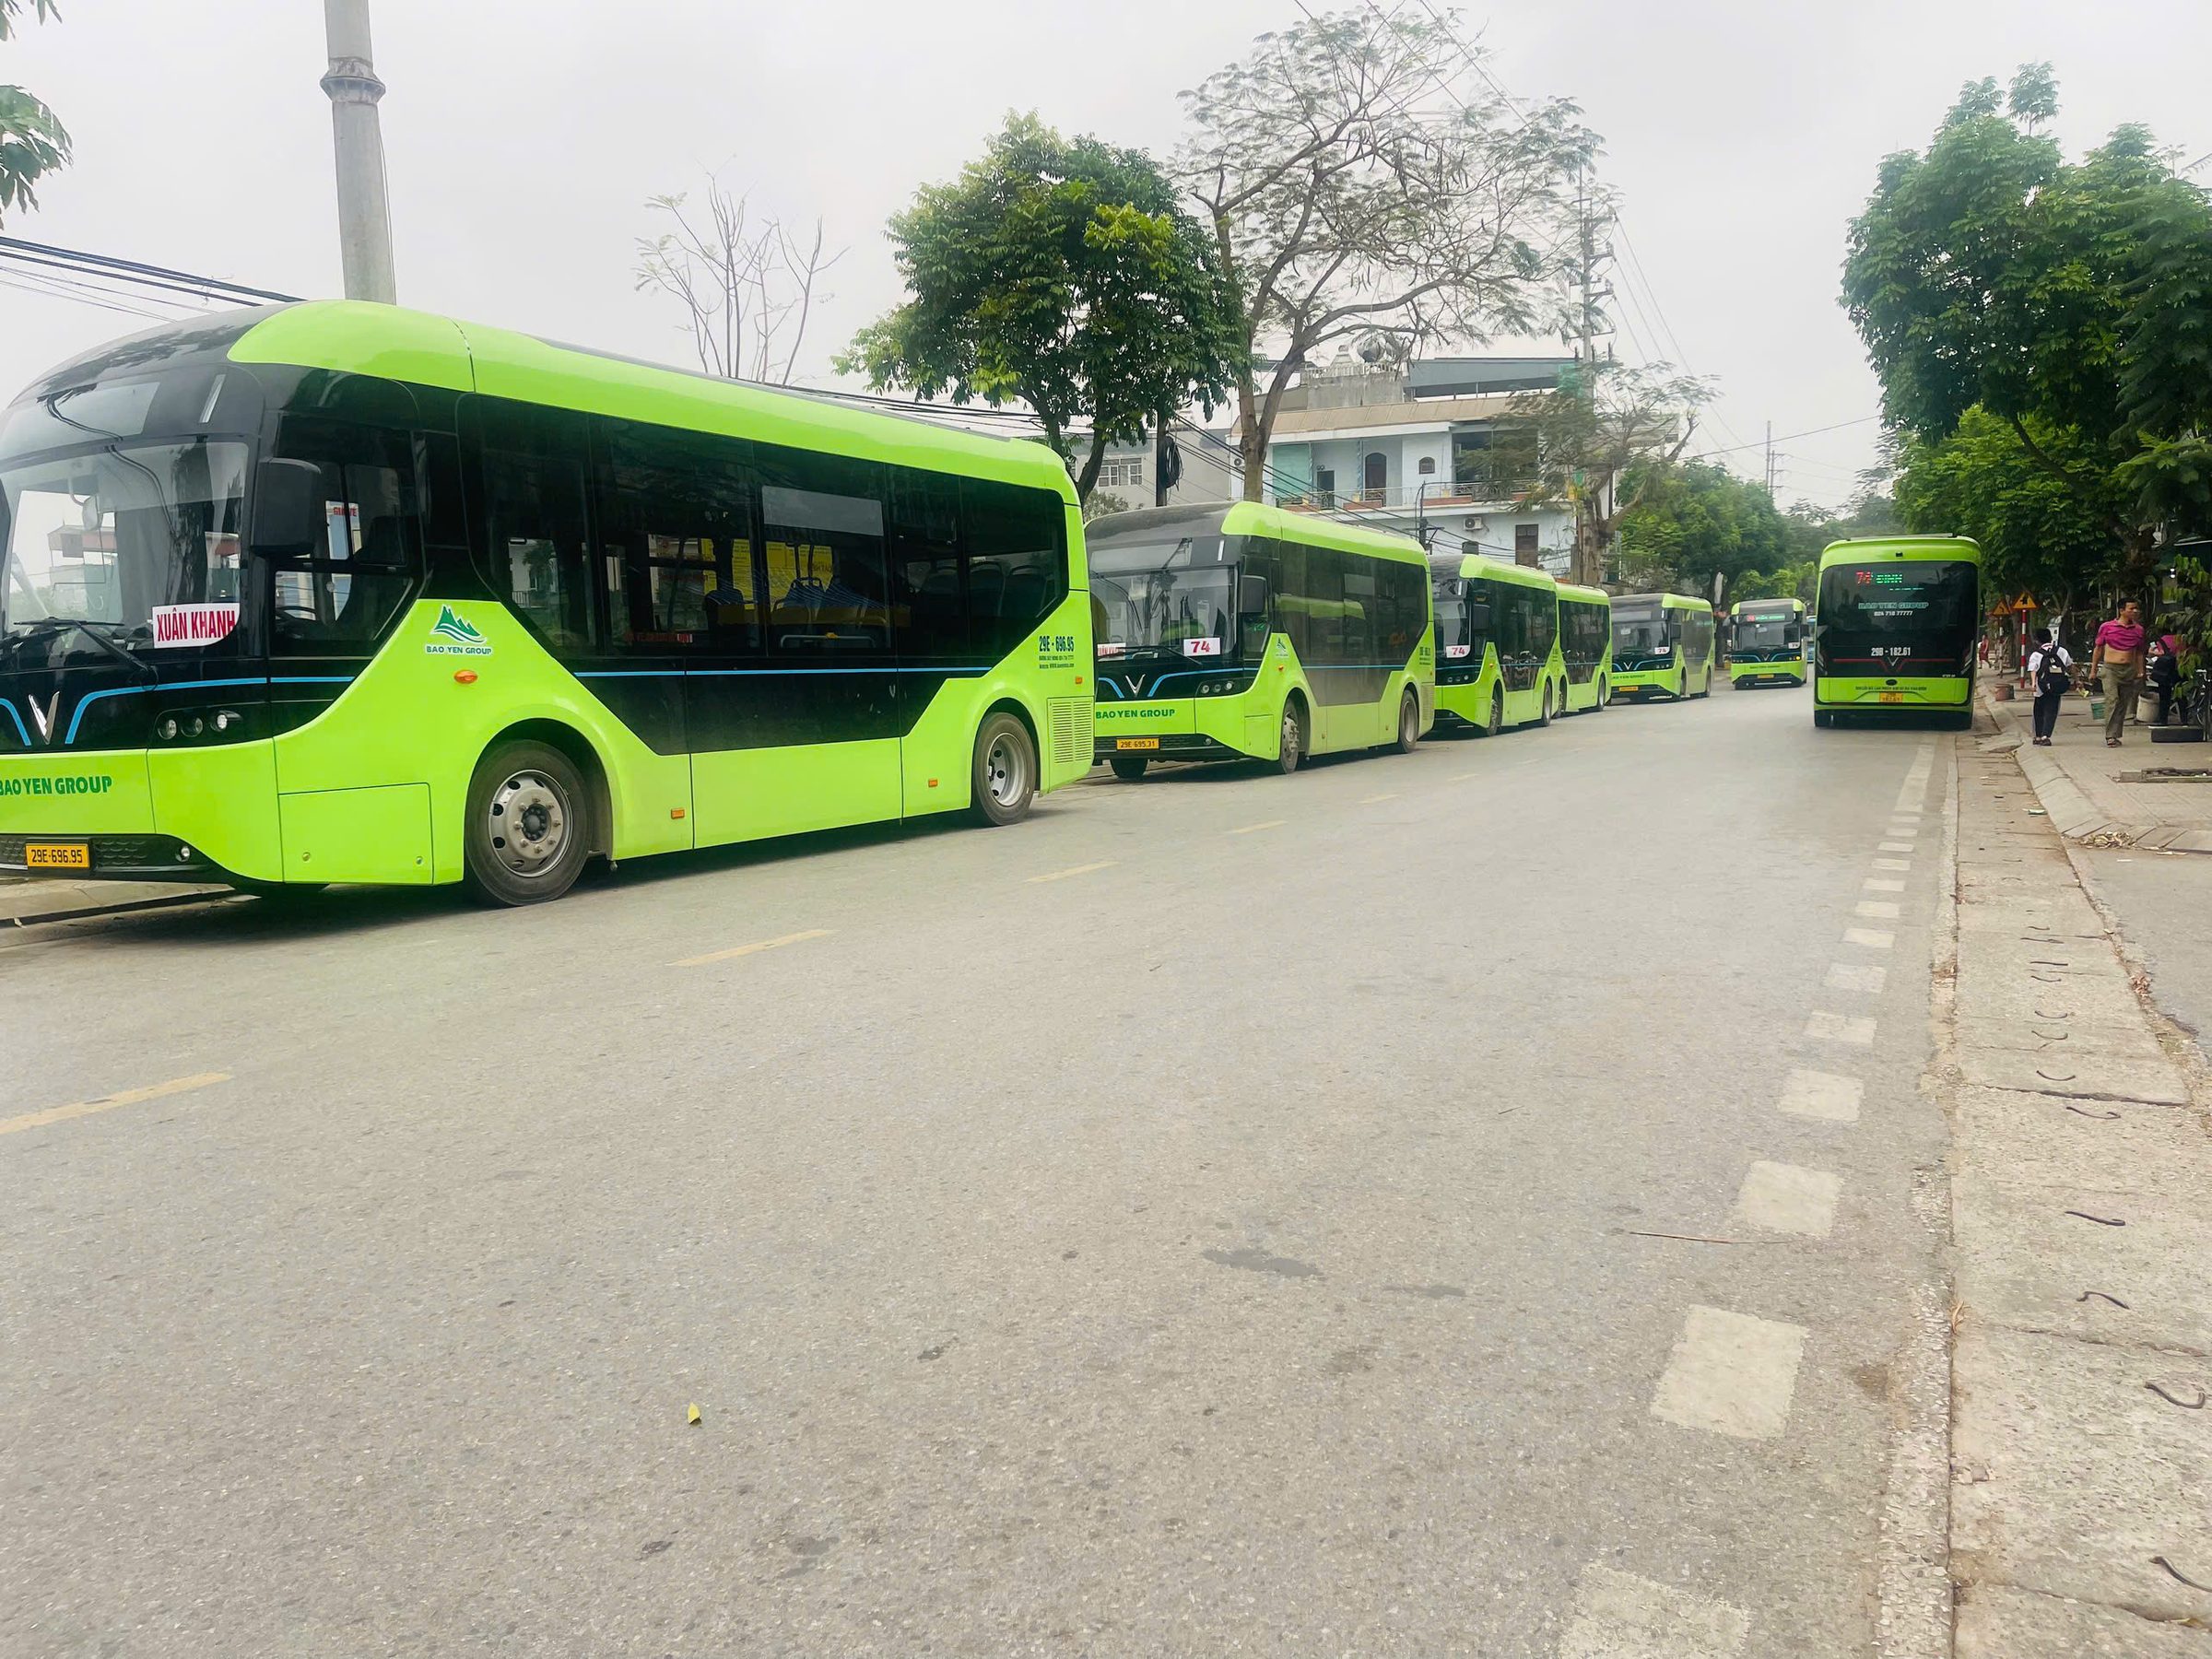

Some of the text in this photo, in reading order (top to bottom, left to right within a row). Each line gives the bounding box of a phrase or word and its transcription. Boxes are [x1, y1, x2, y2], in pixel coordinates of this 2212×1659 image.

[157, 607, 235, 642] XUÂN KHANH
[1190, 641, 1210, 653] 74
[1452, 647, 1465, 655] 74
[1095, 709, 1175, 719] BAO YEN GROUP
[23, 777, 53, 795] YEN
[55, 775, 112, 794] GROUP
[31, 849, 83, 864] 29E-696.95
